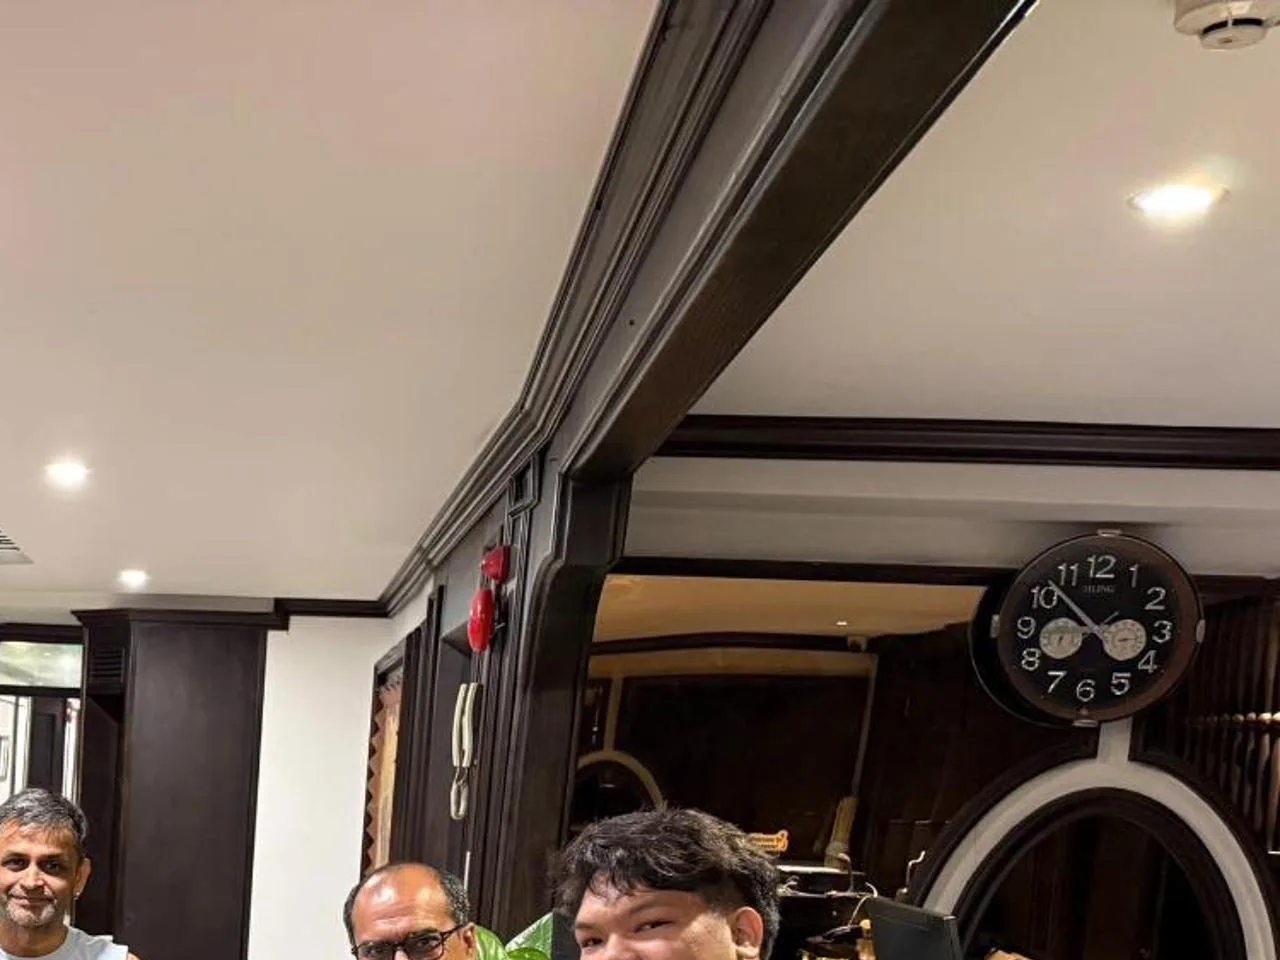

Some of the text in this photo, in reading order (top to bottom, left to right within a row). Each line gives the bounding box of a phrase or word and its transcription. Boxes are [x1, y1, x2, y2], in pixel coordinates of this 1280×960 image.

[1058, 563, 1079, 587] 11
[1087, 555, 1117, 579] 12
[1129, 563, 1140, 588] 1
[1030, 585, 1059, 609] 10
[1145, 586, 1166, 610] 2
[1017, 616, 1037, 640] 9
[1152, 620, 1172, 643] 3
[1021, 648, 1042, 671] 8
[1137, 650, 1158, 674] 4
[1047, 671, 1067, 694] 7
[1076, 679, 1096, 702] 6
[1110, 672, 1131, 695] 5
